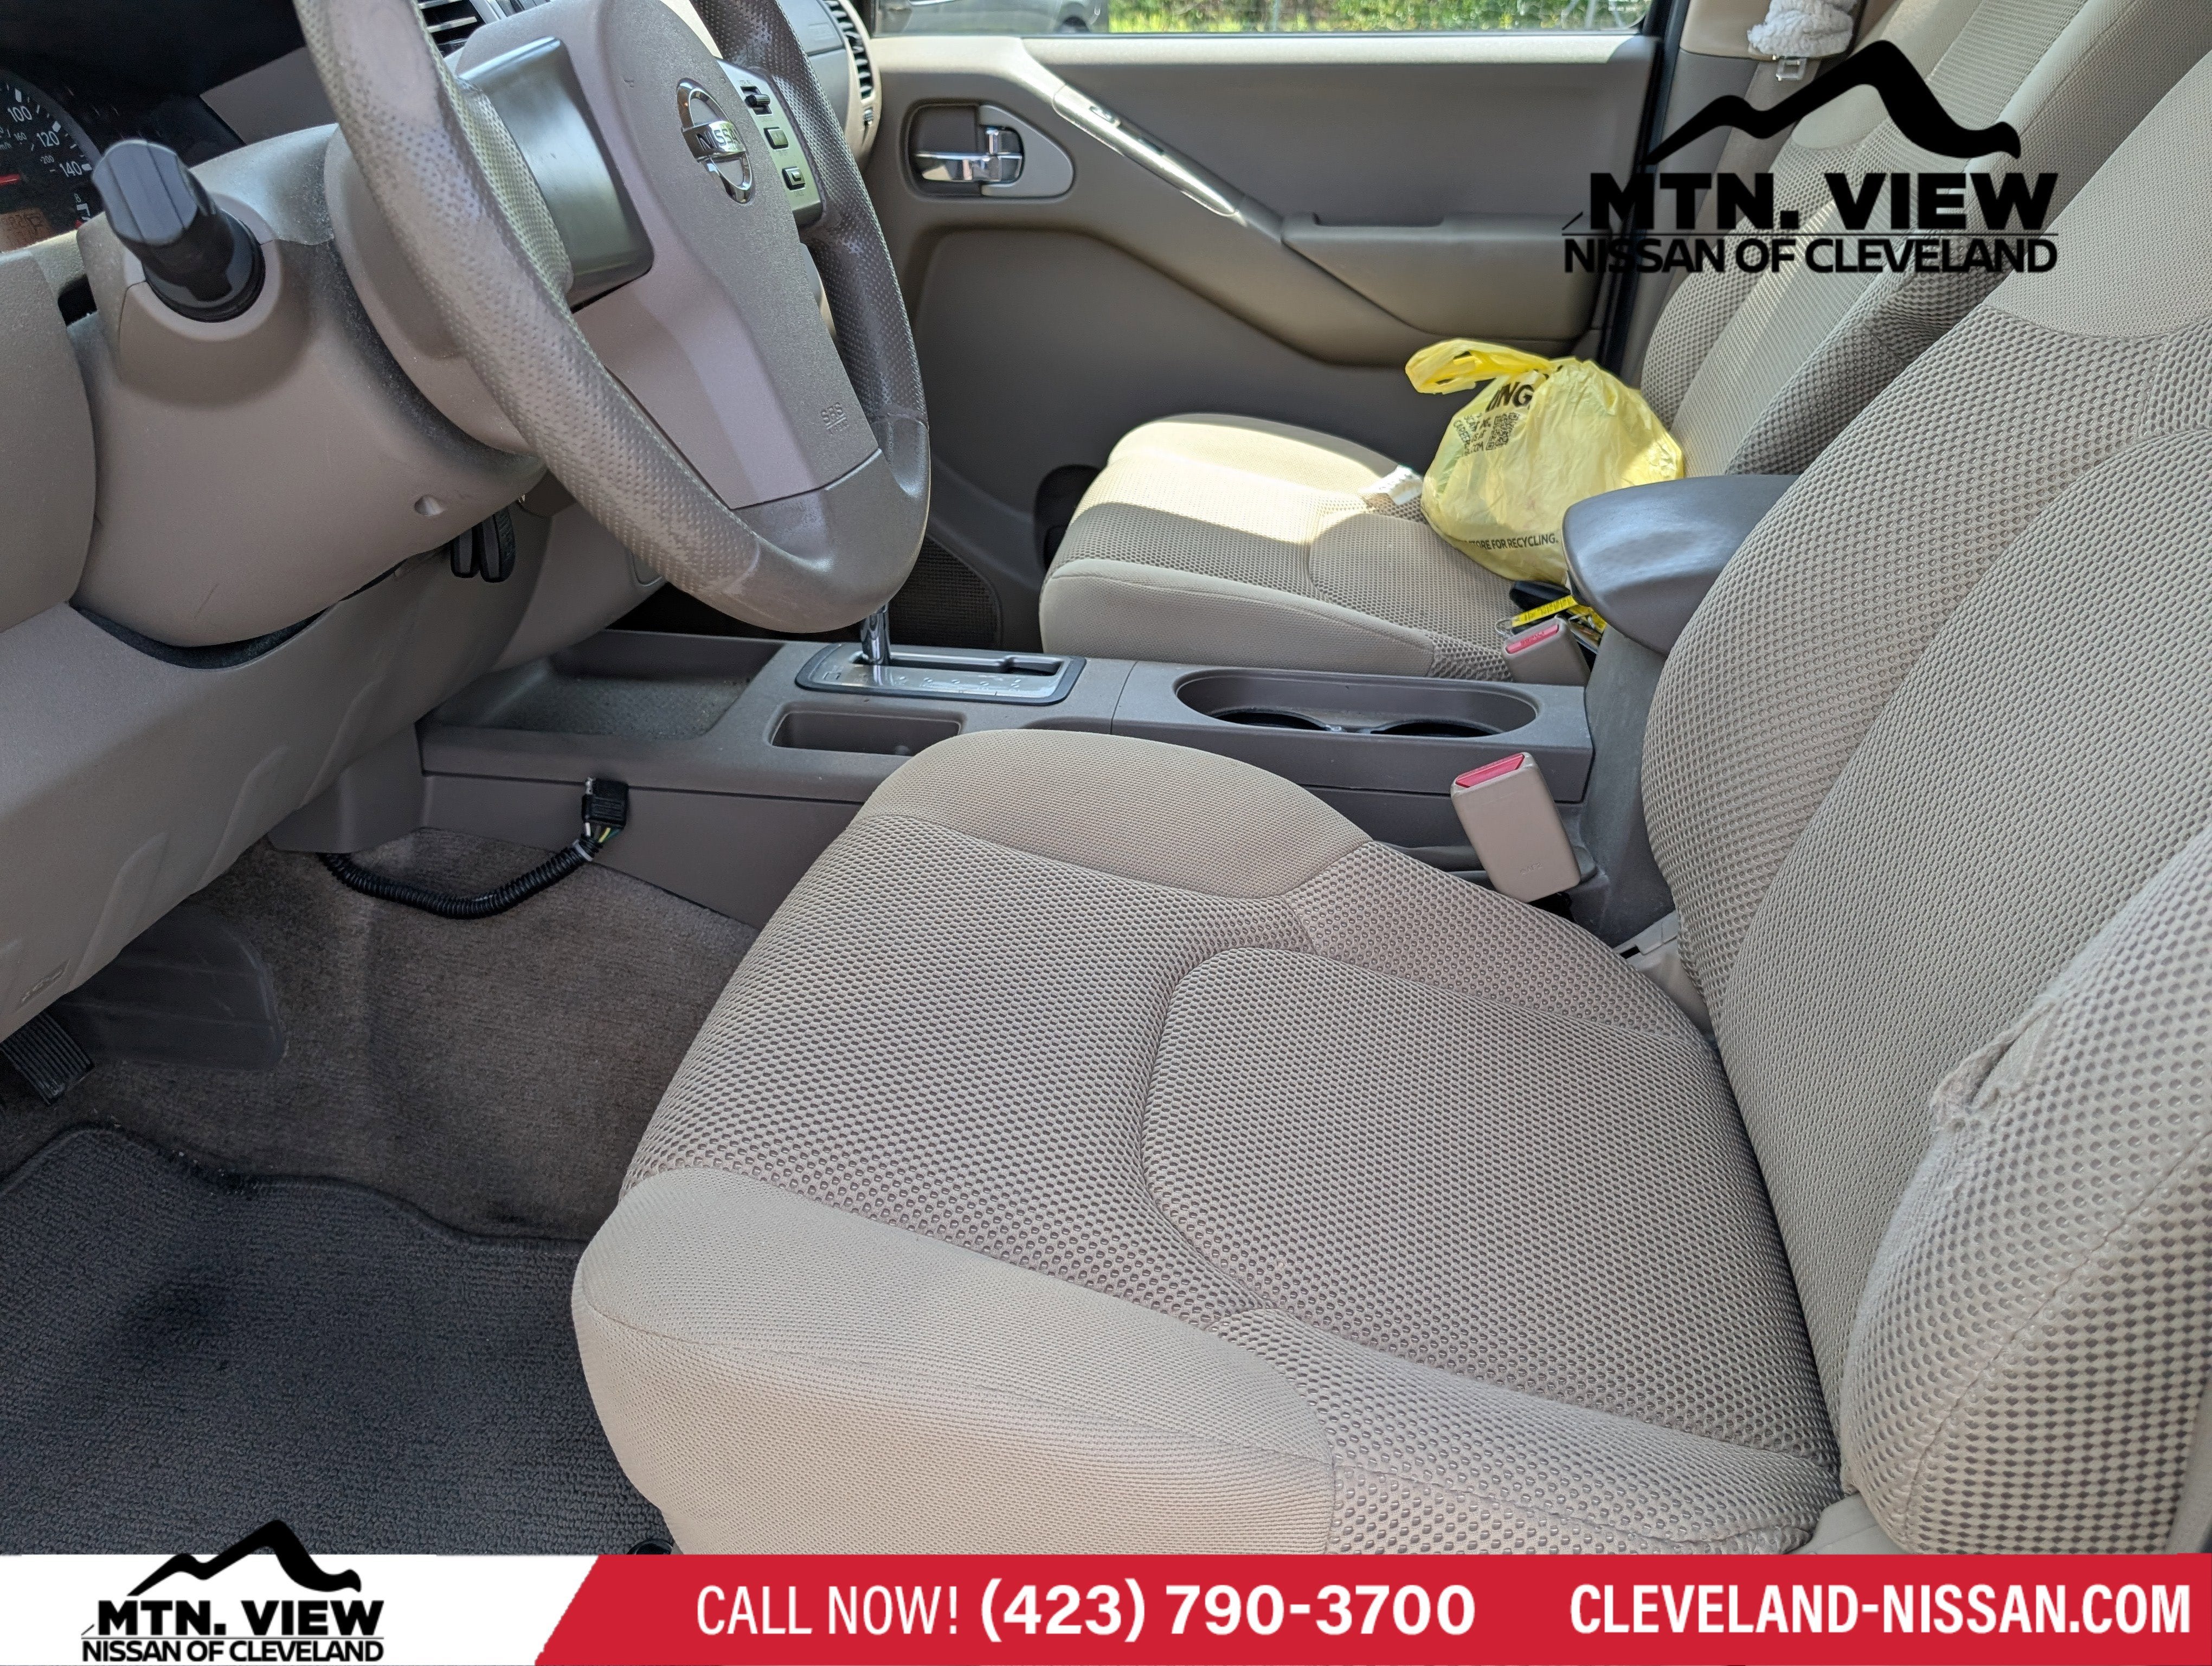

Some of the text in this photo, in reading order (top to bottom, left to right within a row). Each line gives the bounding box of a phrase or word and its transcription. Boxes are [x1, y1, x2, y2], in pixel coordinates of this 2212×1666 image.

[7, 106, 33, 122] 100
[36, 131, 60, 147] 120
[59, 161, 82, 177] 140
[1491, 538, 1507, 550] FOR
[1507, 533, 1559, 549] RECYCLING.
